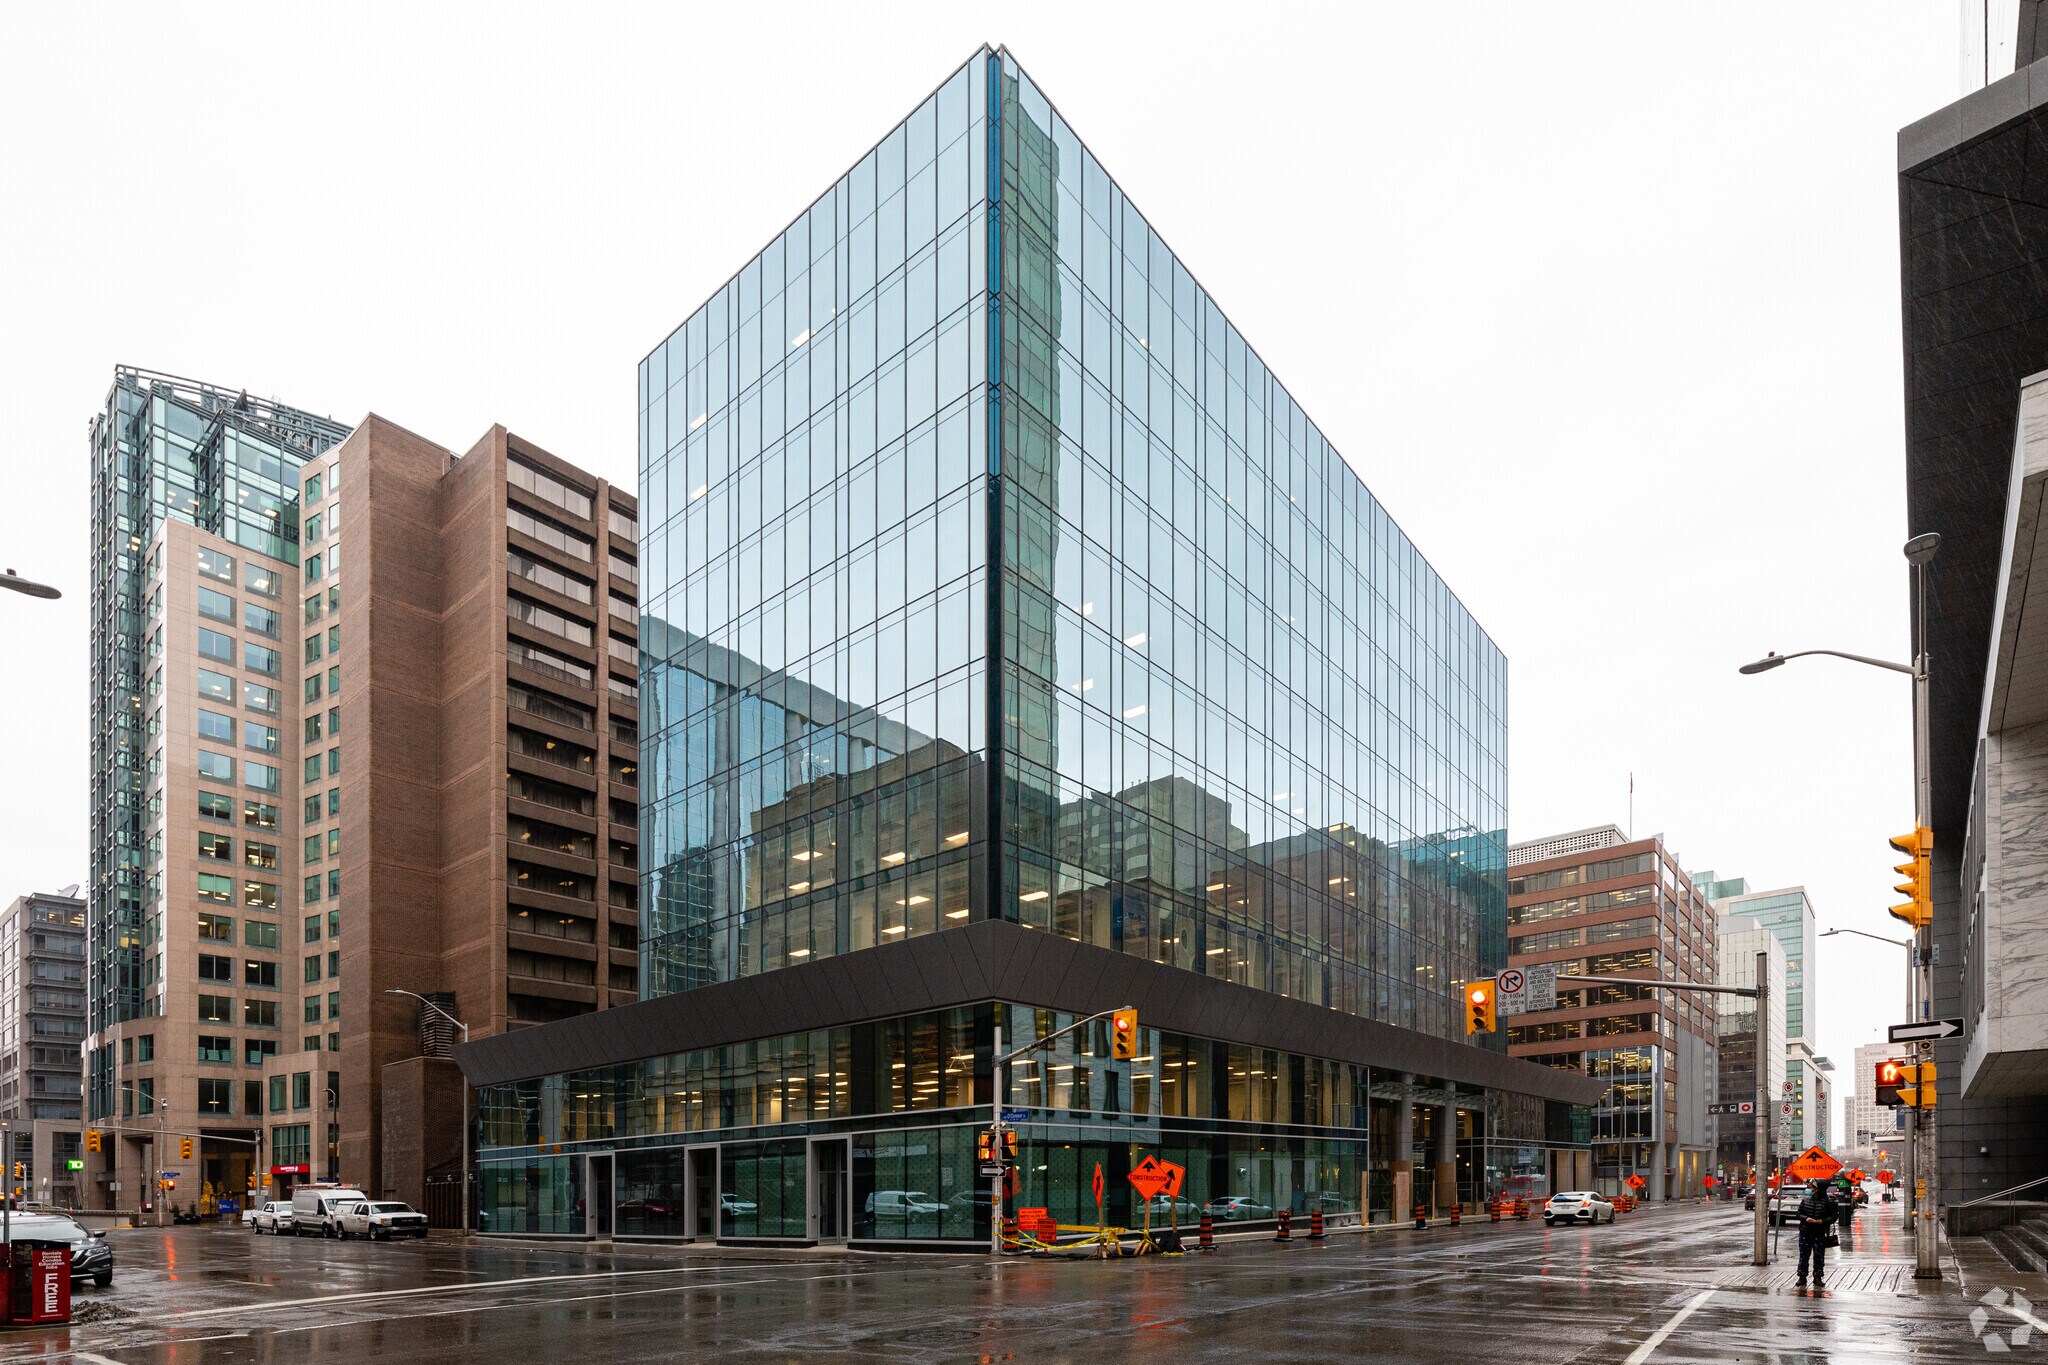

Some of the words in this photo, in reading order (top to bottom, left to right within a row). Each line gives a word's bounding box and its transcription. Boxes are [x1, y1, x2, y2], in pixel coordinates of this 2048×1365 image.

[69, 1160, 84, 1169] TD
[1791, 1163, 1839, 1171] CONSTRUCTION
[1130, 1174, 1167, 1182] CONSTRUCTION
[44, 1272, 59, 1313] FREE
